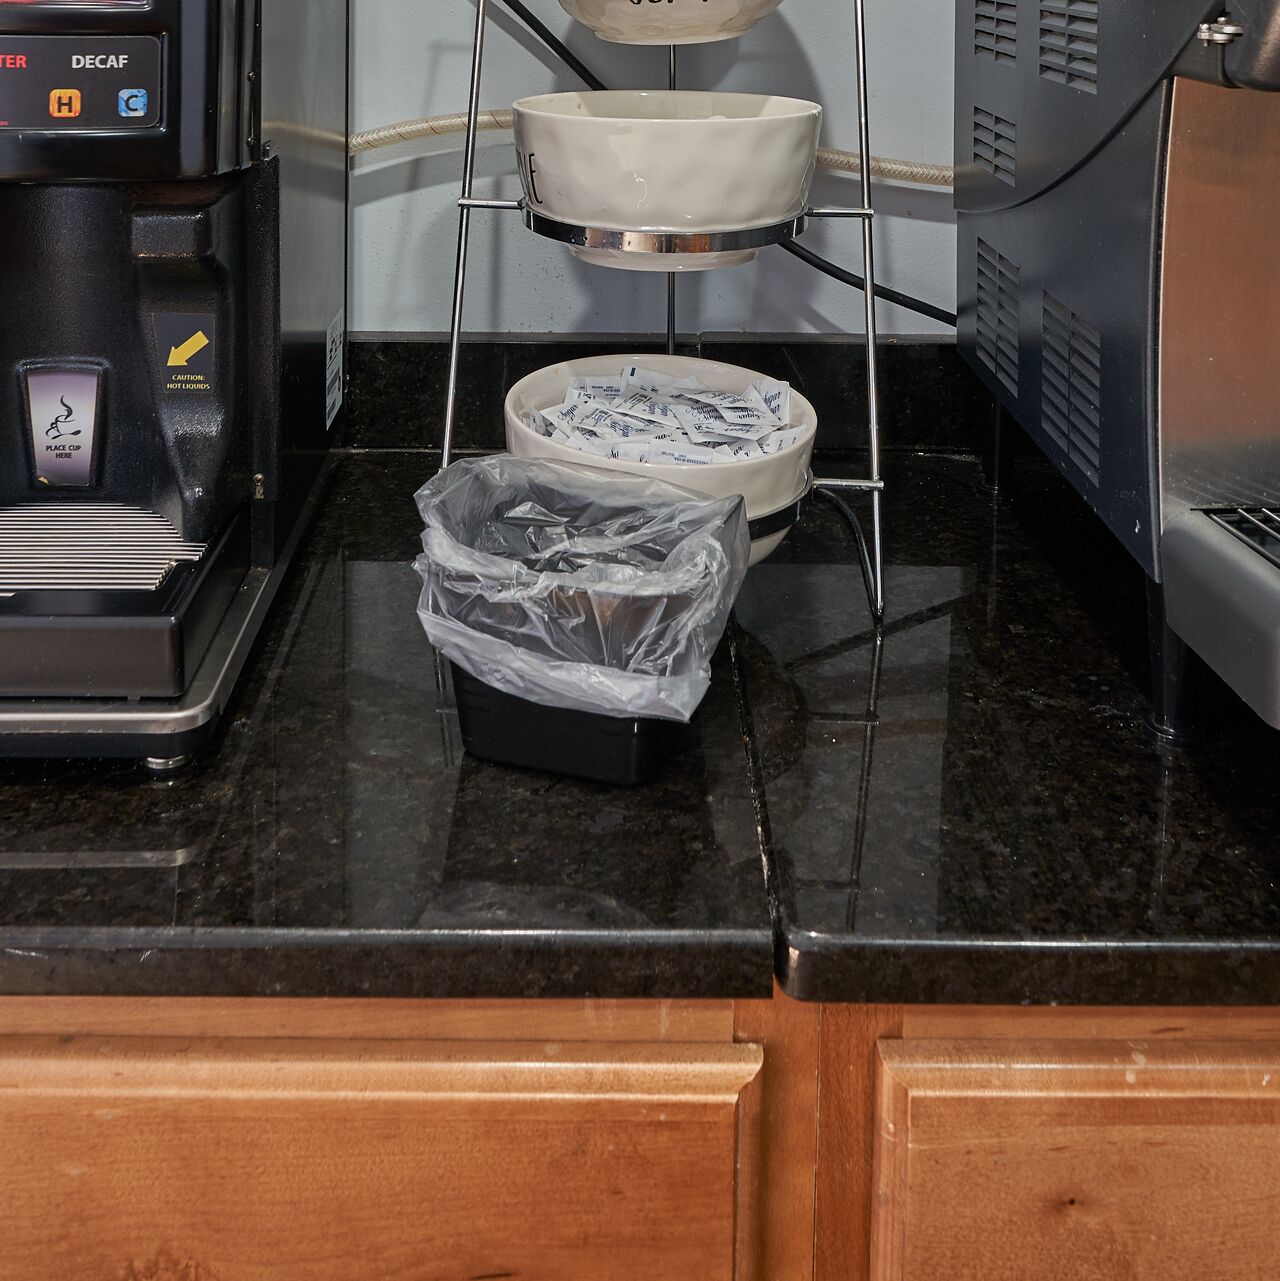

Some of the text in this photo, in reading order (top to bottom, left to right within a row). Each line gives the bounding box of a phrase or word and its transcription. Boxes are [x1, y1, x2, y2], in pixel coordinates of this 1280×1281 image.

[71, 55, 129, 69] DECAF
[57, 95, 73, 113] H
[125, 94, 139, 112] C
